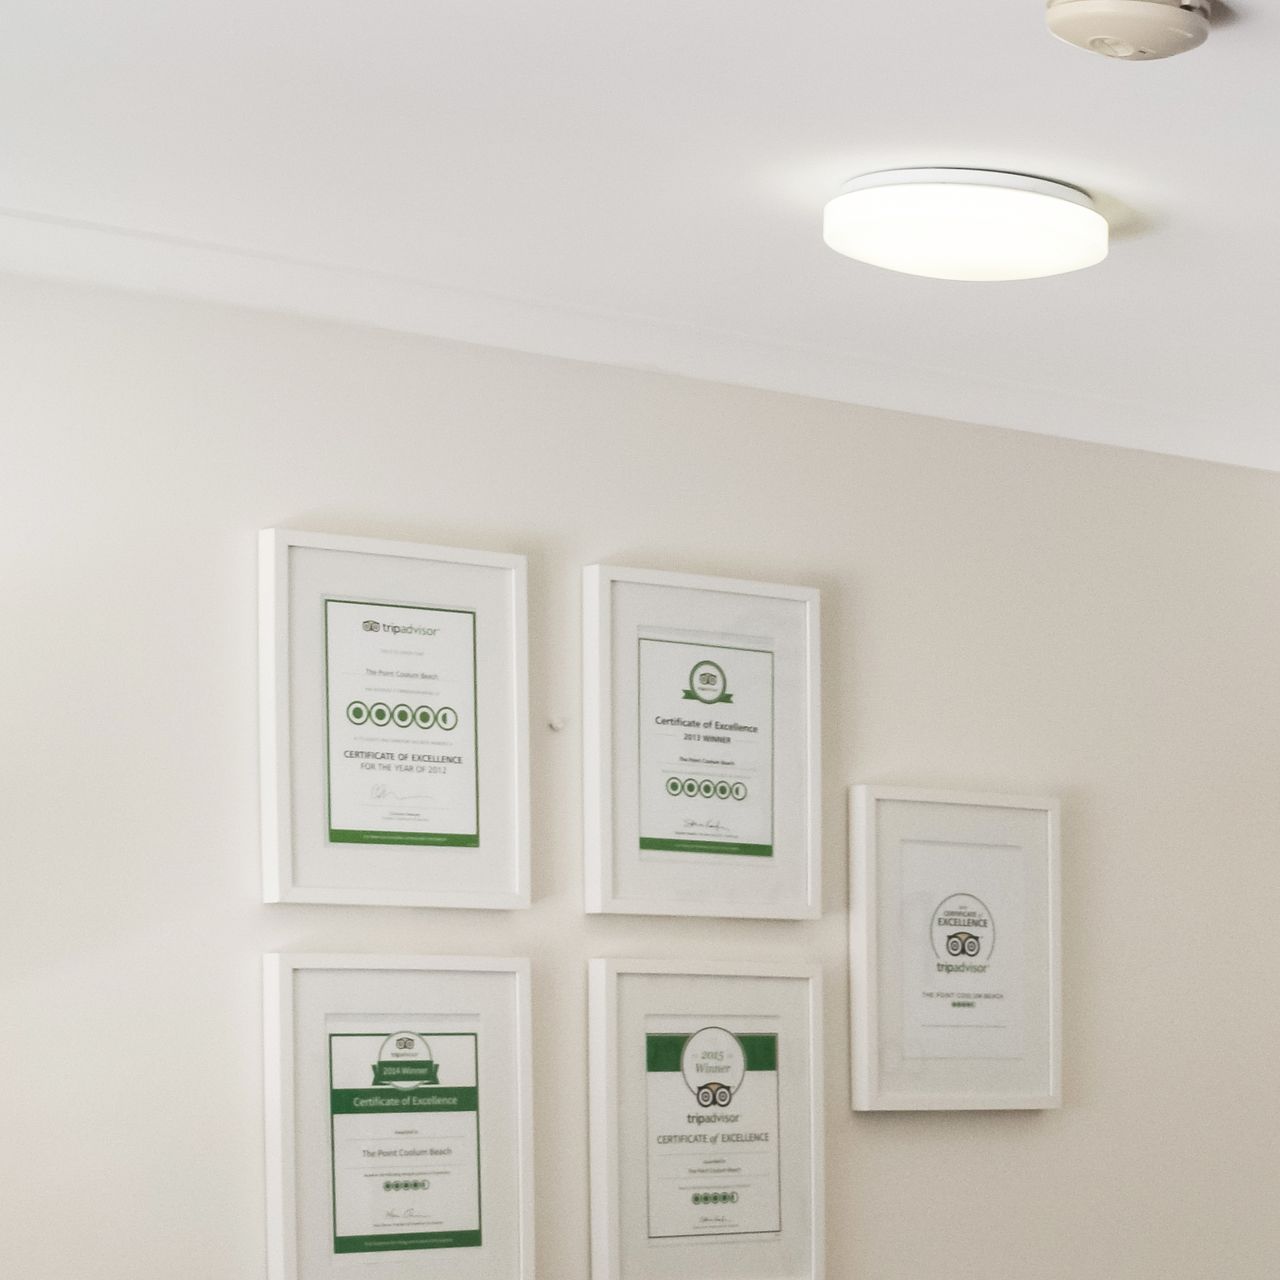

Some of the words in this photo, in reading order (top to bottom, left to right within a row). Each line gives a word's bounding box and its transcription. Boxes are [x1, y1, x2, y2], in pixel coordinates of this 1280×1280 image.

[382, 622, 437, 637] tripadvisor
[654, 716, 701, 728] Certificate
[702, 720, 713, 729] of
[715, 721, 759, 733] Excellence
[343, 750, 396, 762] CERTIFICATE
[397, 752, 409, 762] OF
[411, 753, 464, 765] EXCELLENCE
[360, 762, 377, 770] FOR
[378, 763, 392, 772] THE
[394, 764, 415, 773] YEAR
[415, 765, 427, 773] OF
[937, 917, 988, 928] EXCELLENCE
[936, 962, 987, 975] tripadvisor
[700, 1050, 725, 1062] 2015
[695, 1063, 732, 1074] Winner
[352, 1096, 400, 1107] Certificate
[401, 1095, 411, 1106] of
[412, 1095, 458, 1106] Excellence
[687, 1112, 741, 1126] tripadvisor
[656, 1135, 708, 1145] CERTIFICATE
[709, 1134, 719, 1145] of
[721, 1132, 769, 1144] EXCELLENCE
